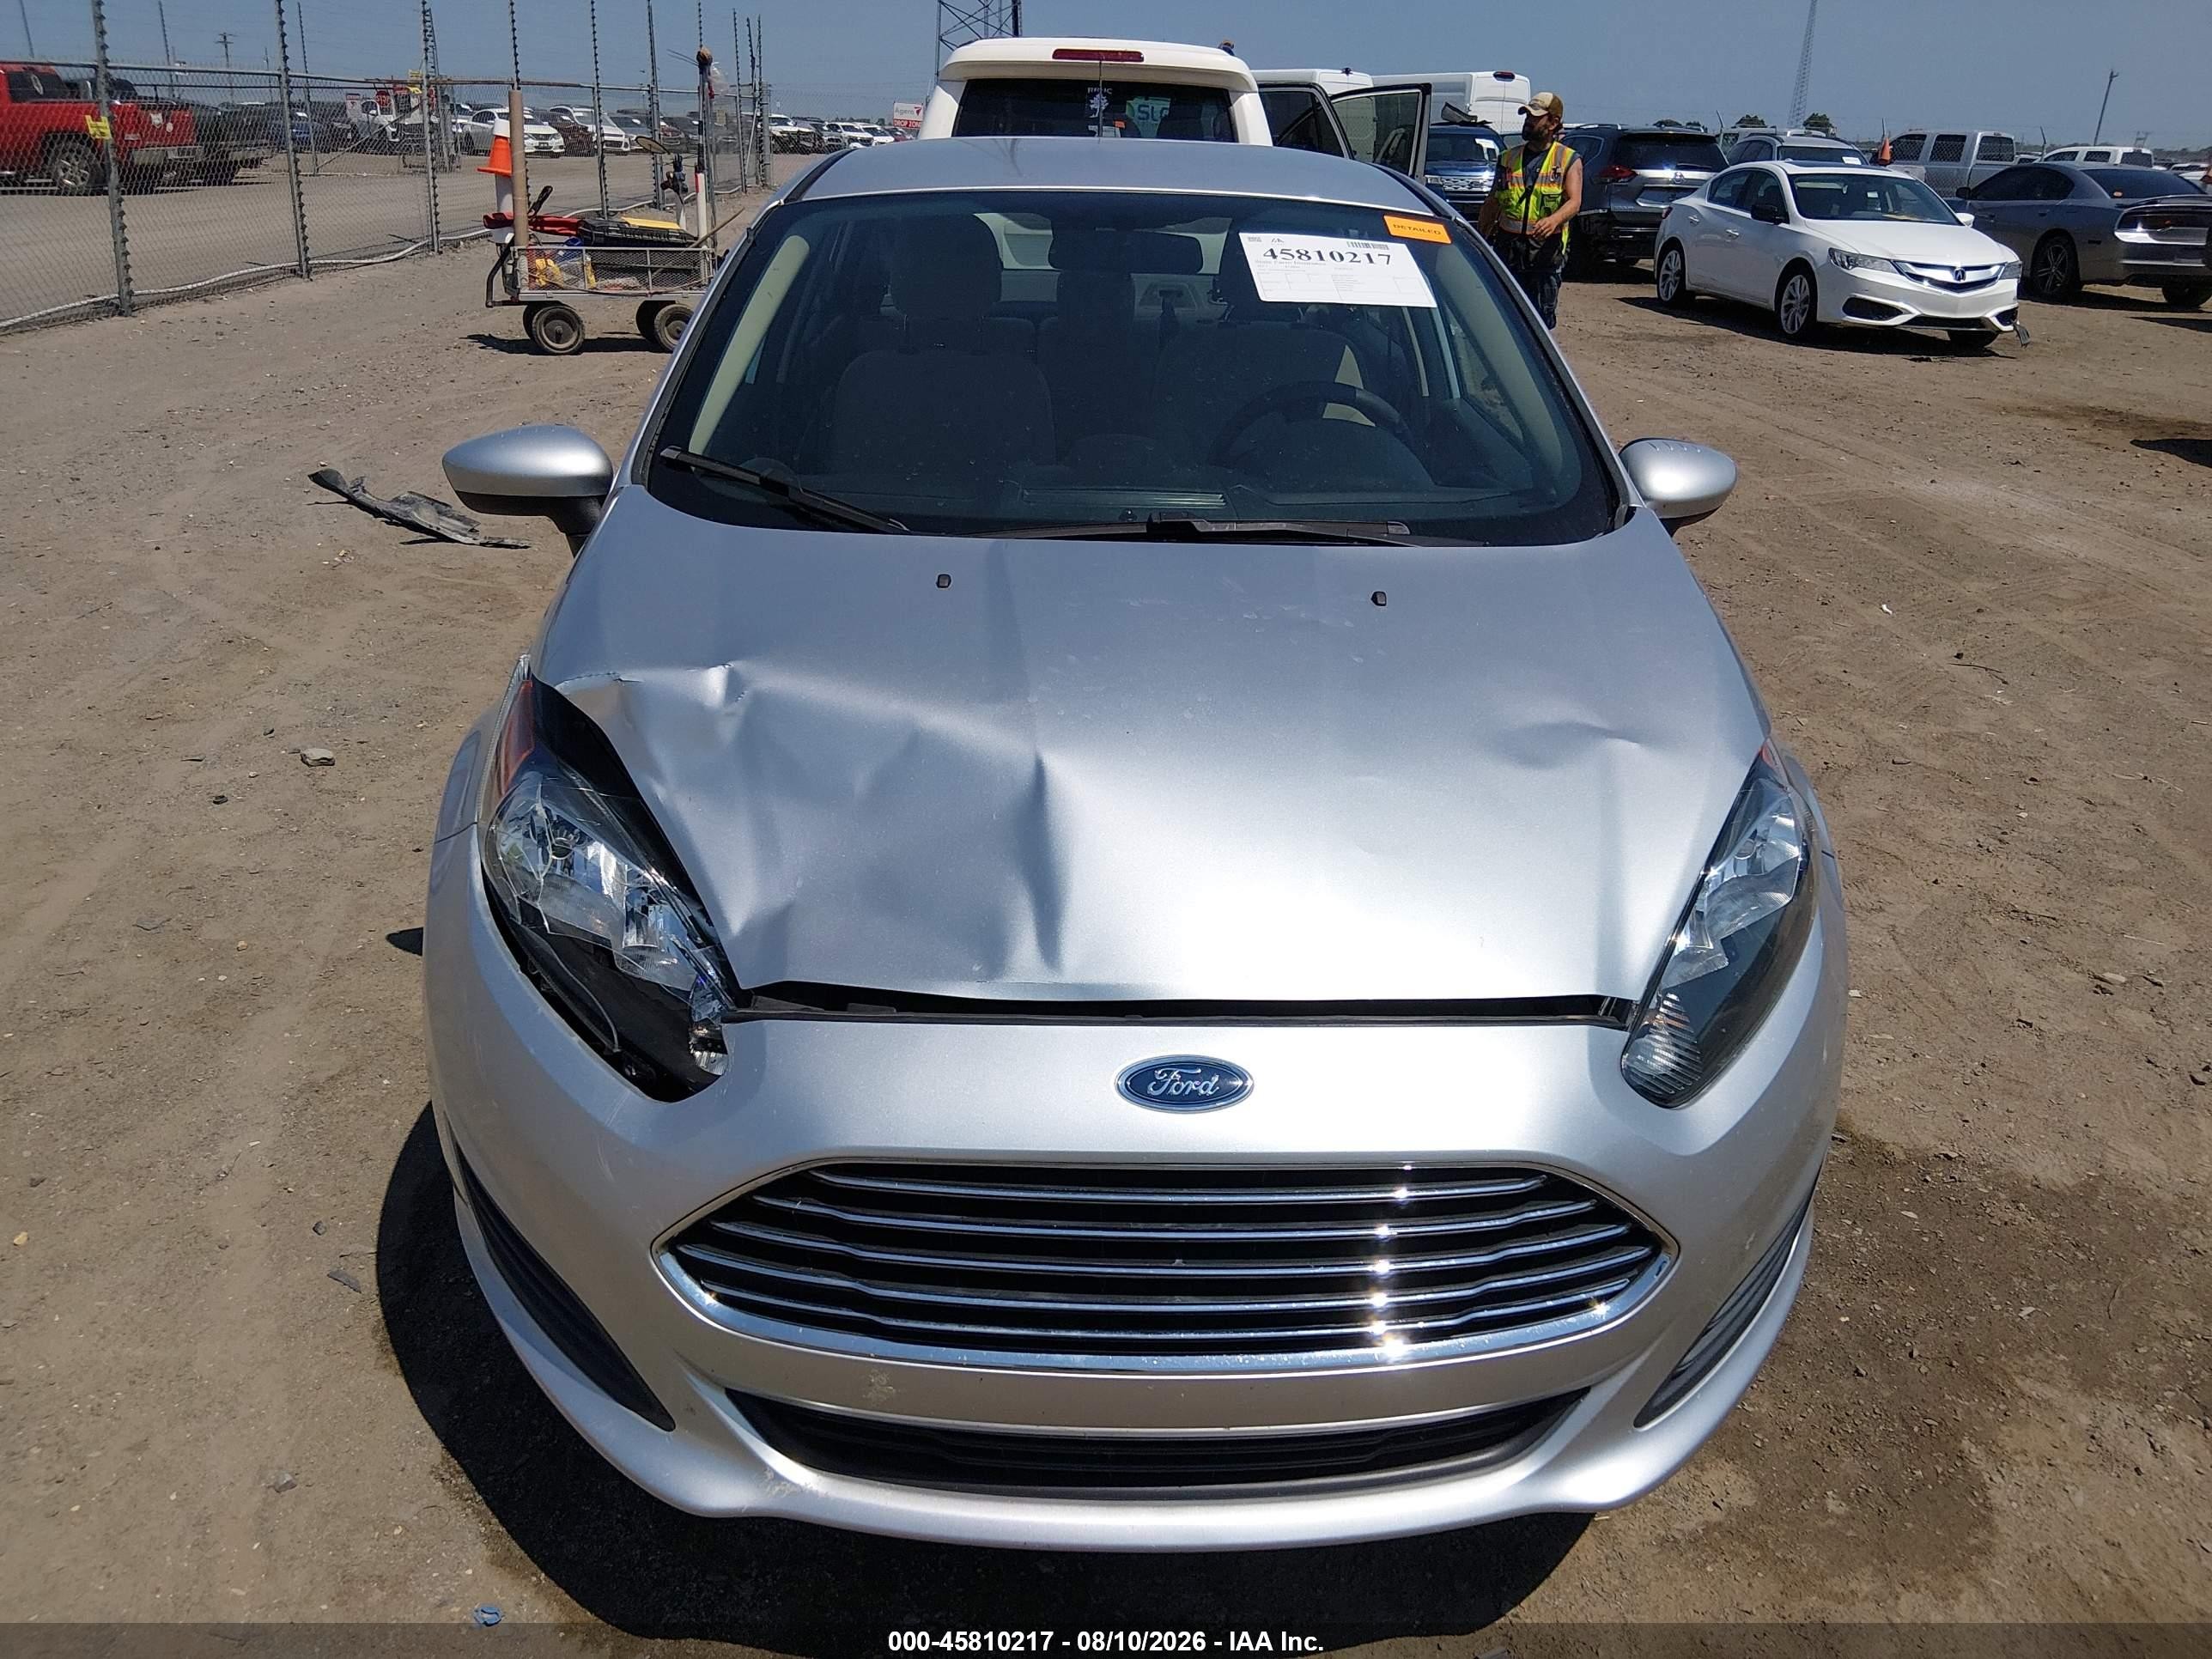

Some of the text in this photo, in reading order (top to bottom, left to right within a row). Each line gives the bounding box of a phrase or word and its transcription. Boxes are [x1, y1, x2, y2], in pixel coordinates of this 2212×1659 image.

[1393, 223, 1441, 235] DETAILED
[1262, 246, 1391, 265] 45810217
[1147, 1067, 1219, 1097] Ford
